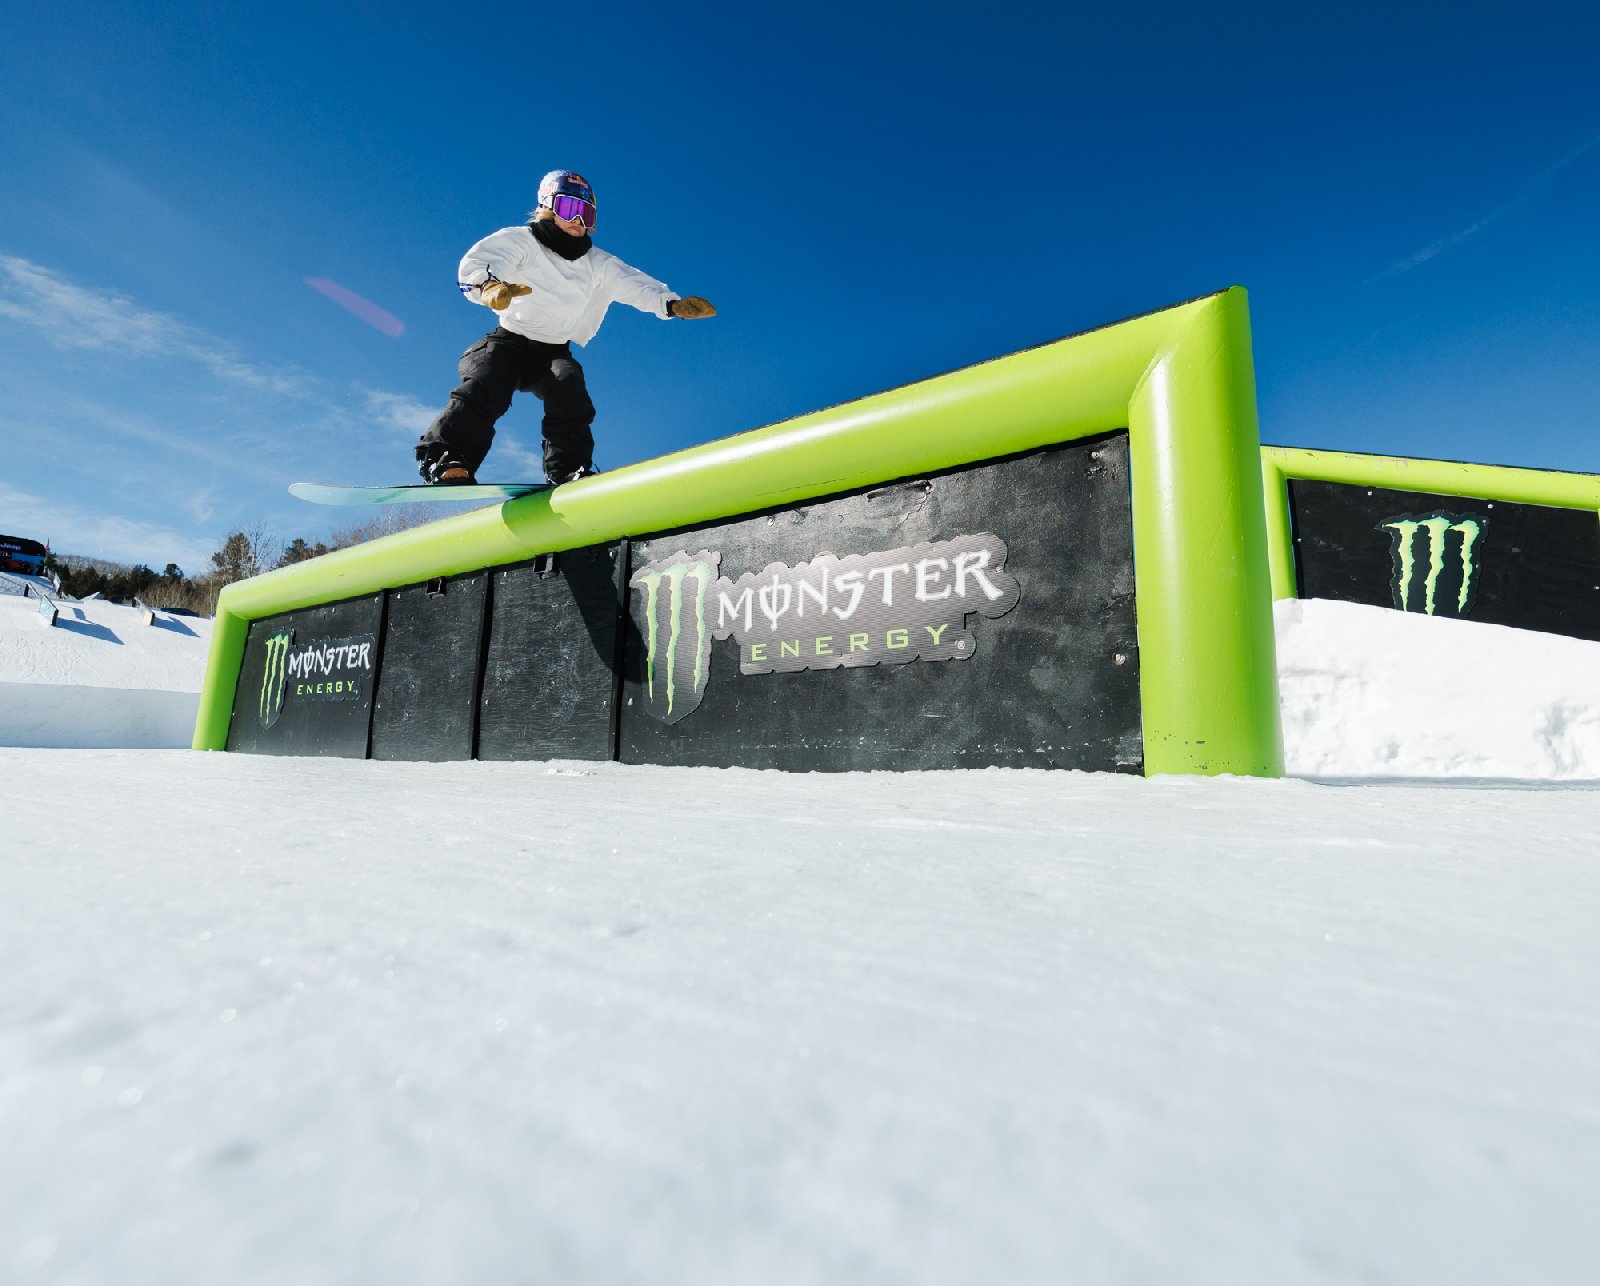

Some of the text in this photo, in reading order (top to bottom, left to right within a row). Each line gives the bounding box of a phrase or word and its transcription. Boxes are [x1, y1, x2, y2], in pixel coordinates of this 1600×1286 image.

[717, 549, 1004, 632] MONSTER
[288, 642, 371, 679] MONSTER
[751, 623, 949, 661] ENERGY
[297, 681, 355, 695] ENERGY
